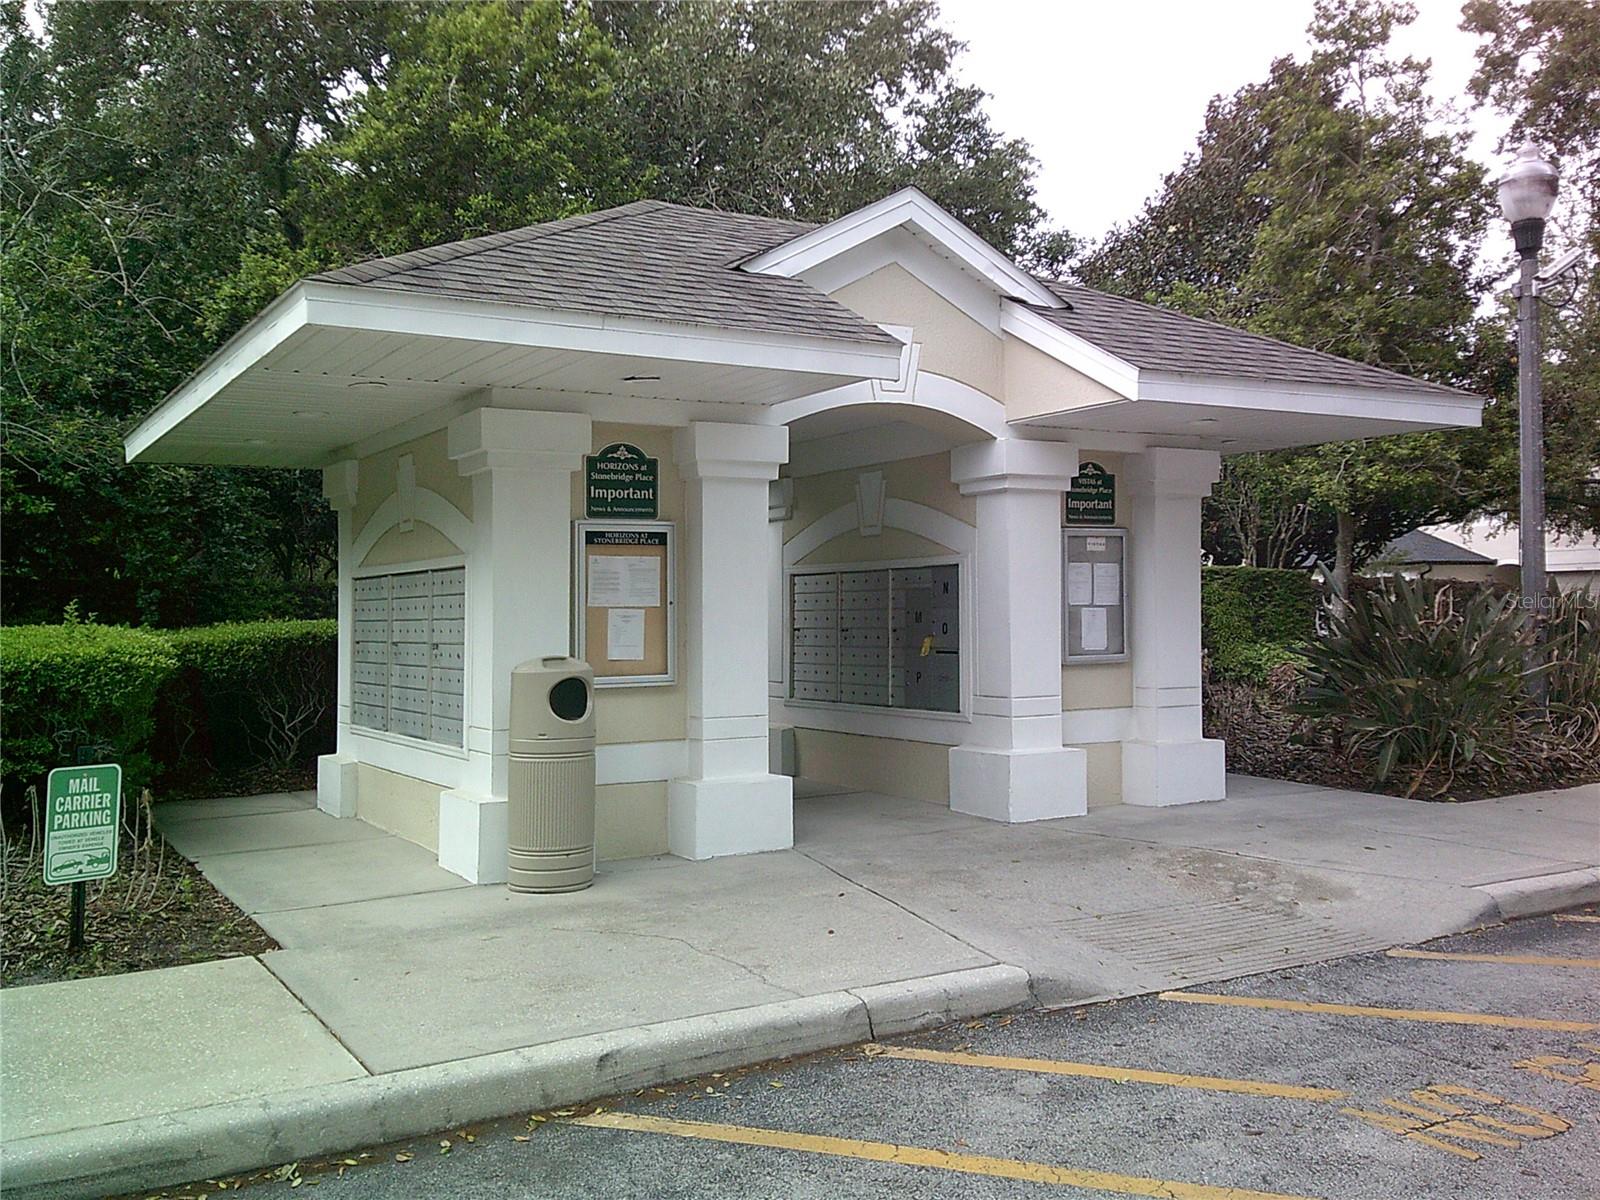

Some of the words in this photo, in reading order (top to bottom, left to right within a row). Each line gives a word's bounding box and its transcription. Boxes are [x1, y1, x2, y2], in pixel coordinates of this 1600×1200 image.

[597, 462, 639, 471] HORIZONS
[591, 472, 634, 482] Stonebridge
[635, 473, 655, 482] Place
[590, 486, 654, 502] Important
[1068, 498, 1112, 512] Important
[942, 581, 949, 595] N
[916, 671, 922, 684] P
[69, 777, 101, 794] MAIL
[55, 792, 111, 813] CARRIER
[53, 809, 111, 830] PARKING
